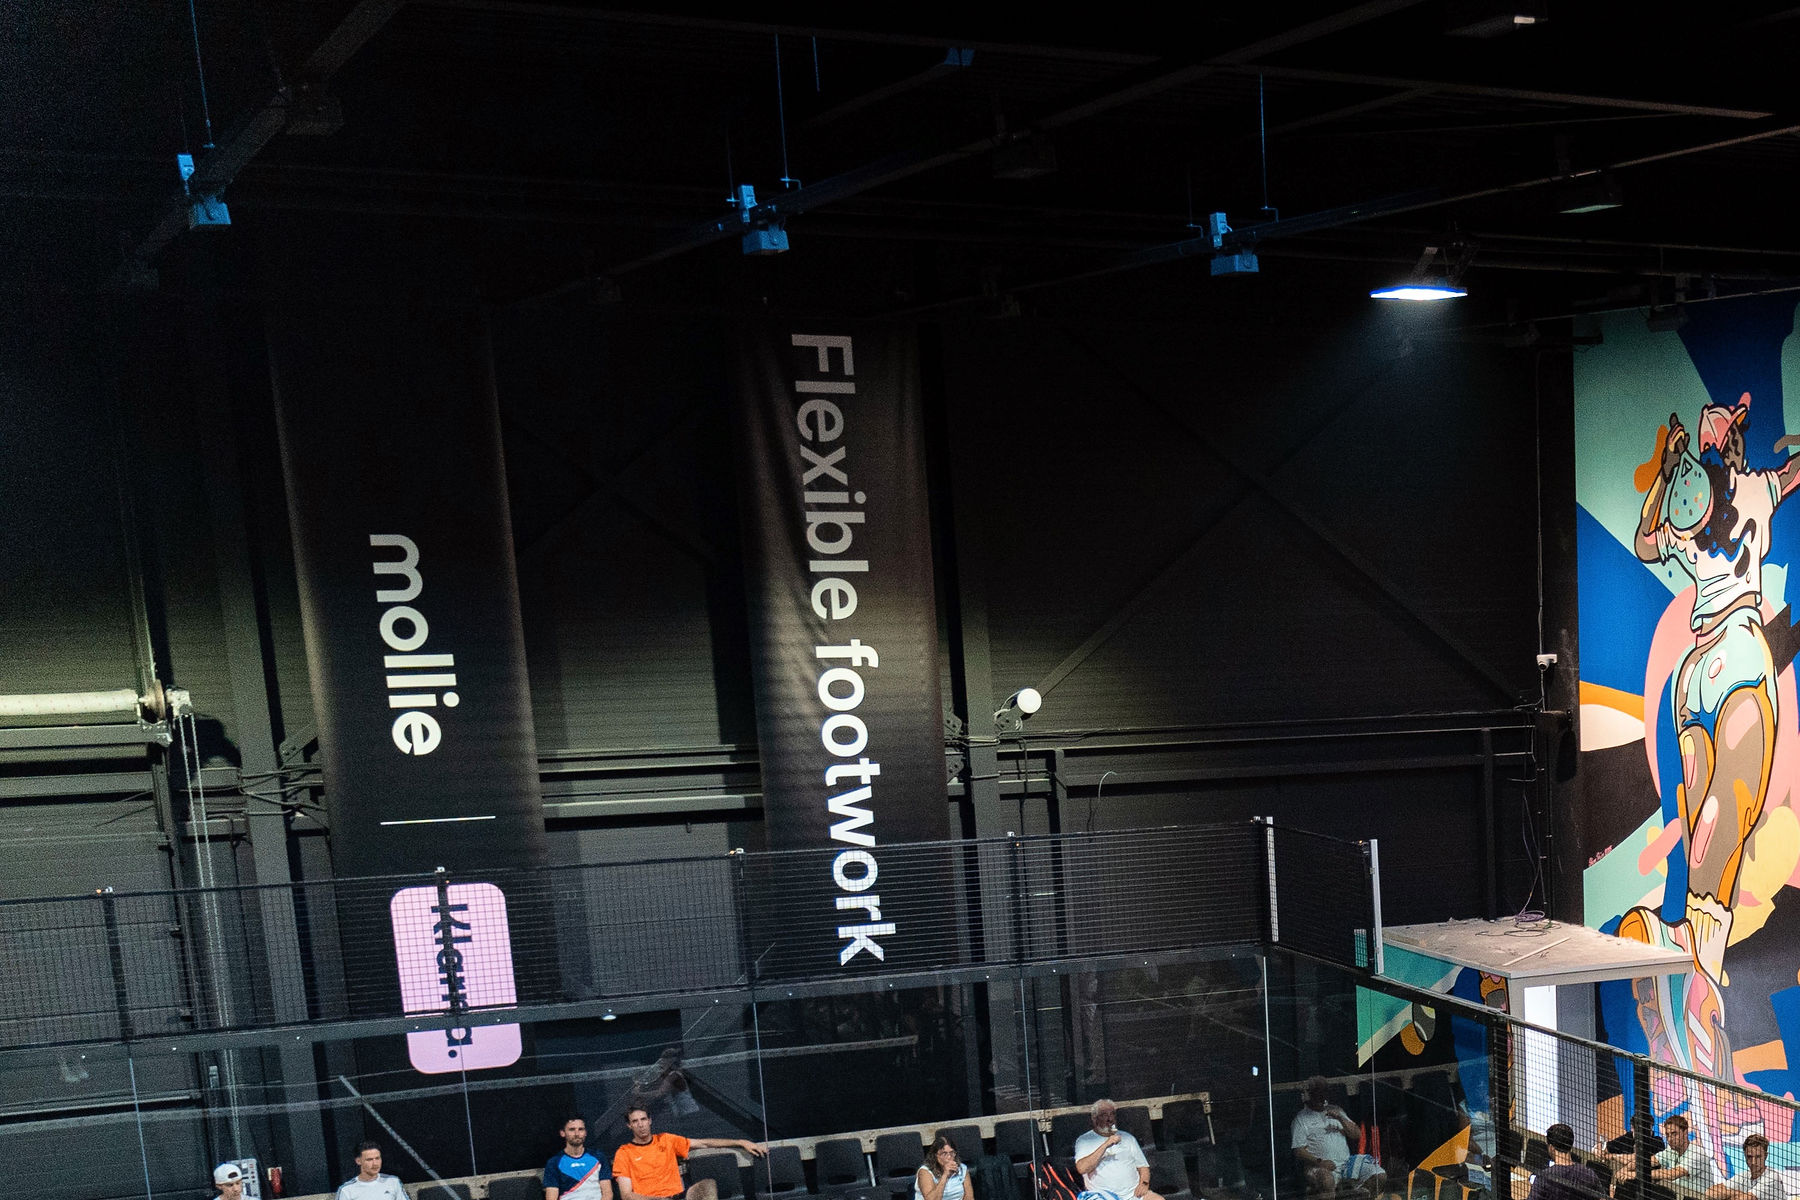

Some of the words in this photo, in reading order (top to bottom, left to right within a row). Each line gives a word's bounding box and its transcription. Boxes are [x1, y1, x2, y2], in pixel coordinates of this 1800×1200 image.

[792, 333, 869, 620] Flexible
[369, 534, 460, 756] mollie
[815, 638, 897, 966] footwork
